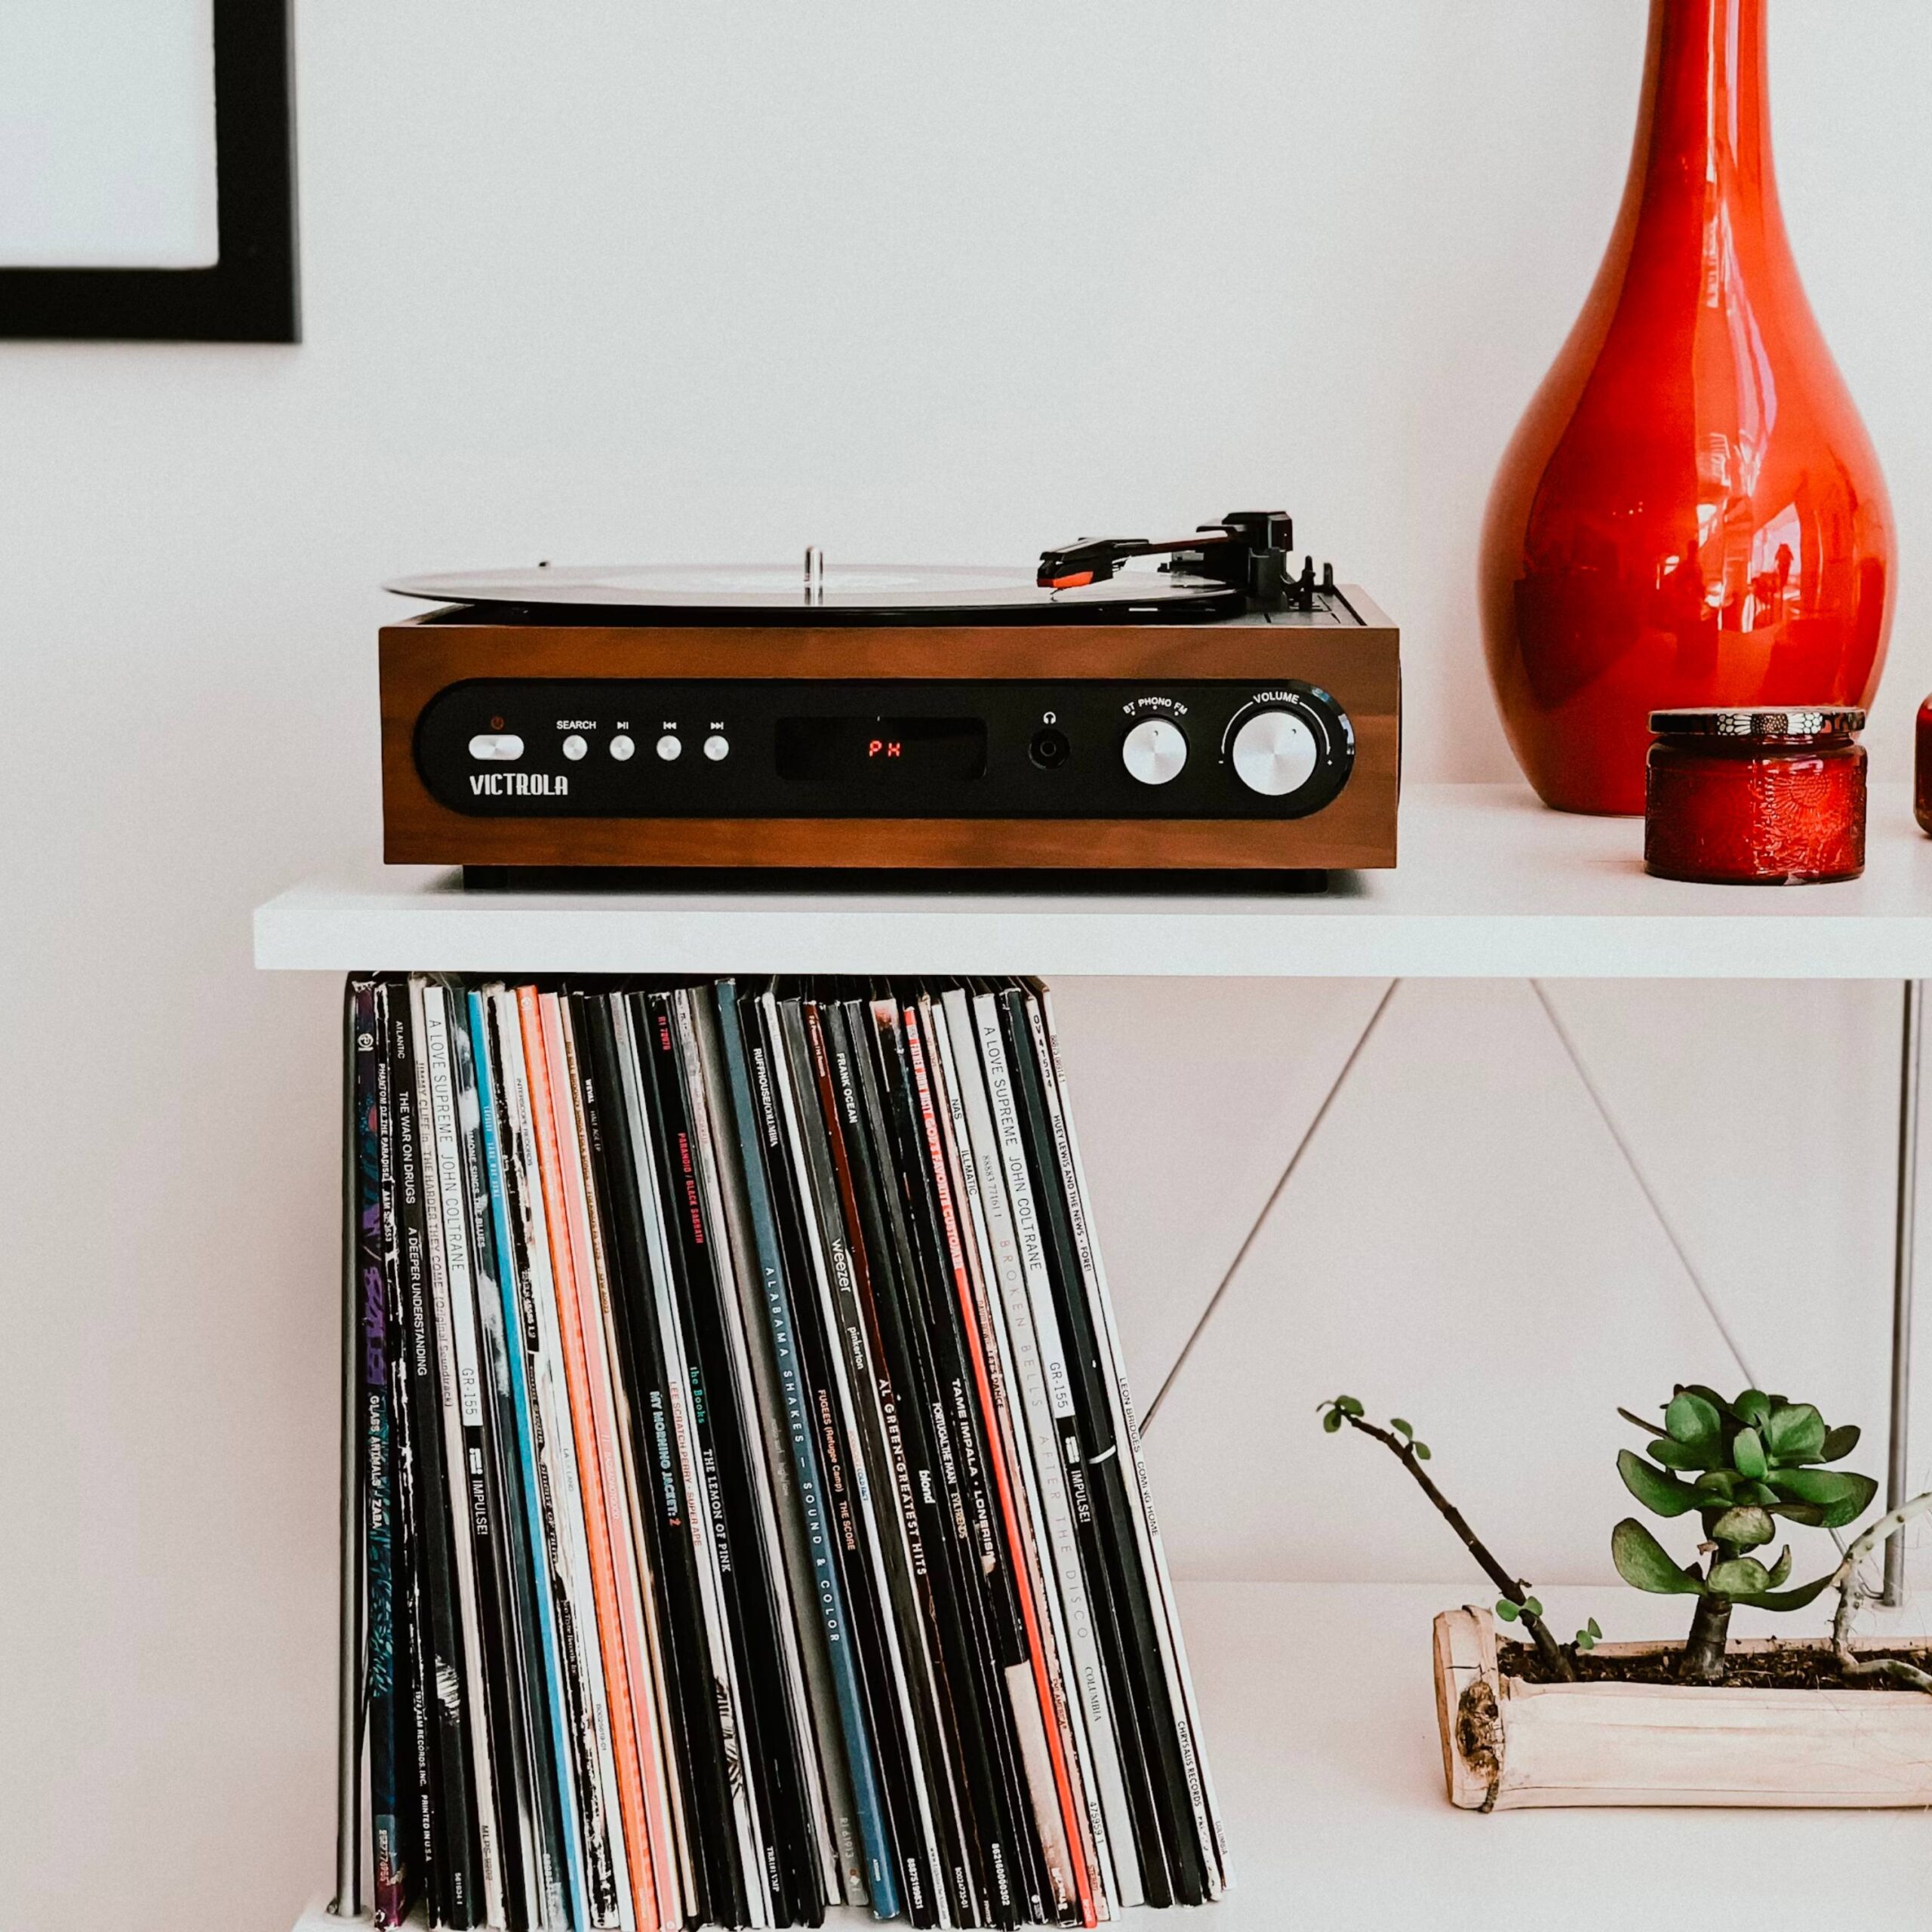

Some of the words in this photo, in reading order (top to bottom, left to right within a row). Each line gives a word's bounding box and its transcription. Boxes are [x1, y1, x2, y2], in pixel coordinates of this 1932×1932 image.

[1123, 702, 1137, 715] BT
[1138, 697, 1172, 708] PHONO
[1173, 702, 1189, 715] FM
[1253, 691, 1300, 704] VOLUME
[556, 721, 596, 730] SEARCH
[469, 774, 568, 795] VICTROLA
[395, 1021, 405, 1058] ATLANTIC
[429, 1035, 445, 1068] LOVE
[909, 1043, 924, 1069] FATHER
[986, 1041, 1004, 1072] LOVE
[377, 1063, 387, 1103] PHANTOM
[416, 1060, 426, 1096] JIMMY
[835, 1053, 851, 1087] FRANK
[914, 1072, 928, 1090] JOHN
[398, 1091, 410, 1112] THE
[583, 1079, 595, 1103] WEVAL
[752, 1048, 779, 1147] RUFFHOUSE/COLUMBIA
[842, 1089, 858, 1123] OCEAN
[918, 1092, 933, 1114] MISTY
[418, 1100, 429, 1130] CLIFF
[433, 1075, 452, 1143] SUPREME
[516, 1078, 528, 1127] INTERSCOPE
[522, 1128, 534, 1166] RECORDS
[949, 1099, 963, 1120] NAS
[993, 1079, 1019, 1146] SUPREME
[380, 1119, 389, 1135] THE
[399, 1116, 411, 1142] WAR
[923, 1118, 940, 1152] GOD'S
[1051, 1115, 1064, 1138] HUEY
[380, 1137, 390, 1177] PARADISE
[676, 1133, 692, 1173] PARANOID
[981, 1155, 995, 1182] 88883
[1057, 1141, 1070, 1167] LEWIS
[403, 1164, 415, 1204] DRUGS
[440, 1154, 457, 1191] JOHN
[469, 1165, 480, 1192] SINGS
[931, 1155, 951, 1205] FAVORITE
[960, 1149, 977, 1195] ILLMATIC
[1008, 1155, 1027, 1192] JOHN
[1063, 1170, 1075, 1188] AND
[423, 1175, 437, 1220] HARDER
[685, 1180, 697, 1205] BLACK
[987, 1184, 1000, 1210] 77161
[1067, 1190, 1078, 1206] THE
[428, 1223, 440, 1251] THEY
[445, 1198, 464, 1271] COLTRANE
[474, 1217, 486, 1247] BLUES
[689, 1208, 704, 1244] SABBATH
[1016, 1198, 1043, 1271] COLTRANE
[1071, 1208, 1084, 1235] NEWS
[941, 1208, 964, 1270] CUSTOMER
[408, 1238, 420, 1280] DEEPER
[1079, 1246, 1092, 1272] FORE!
[829, 1238, 851, 1292] weezer
[846, 1326, 866, 1369] pinkerton
[411, 1283, 427, 1376] UNDERSTANDING
[460, 1368, 477, 1414] GR-155
[669, 1381, 679, 1400] LEE
[688, 1367, 700, 1384] the
[991, 1377, 1004, 1408] DANCE
[1048, 1362, 1069, 1408] GR-155
[1118, 1377, 1131, 1404] LEON
[368, 1395, 380, 1432] GLASS
[692, 1389, 707, 1423] Books
[817, 1389, 832, 1425] FUGEES
[950, 1378, 968, 1418] TAME
[651, 1411, 672, 1469] MORNING
[672, 1402, 687, 1448] SCRATCH
[998, 1240, 1026, 1327] BROKEN
[1020, 1346, 1043, 1407] BELLS
[1038, 1436, 1061, 1499] AFTER
[1054, 1516, 1072, 1553] THE
[1064, 1571, 1089, 1638] DISCO
[1124, 1407, 1141, 1452] BRIDGES
[369, 1436, 382, 1486] ANIMALS
[702, 1449, 715, 1472] THE
[764, 1267, 789, 1356] ALABAMA
[782, 1370, 804, 1443] SHAKES
[801, 1482, 823, 1544] SOUND
[819, 1580, 840, 1641] COLOR
[822, 1427, 839, 1463] (Refugee
[958, 1422, 979, 1476] IMPALA
[679, 1451, 692, 1483] PERRY
[829, 1465, 844, 1492] Camp)
[1135, 1461, 1152, 1503] COMING
[660, 1472, 678, 1516] JACKET:
[706, 1476, 723, 1519] LEMON
[918, 1470, 935, 1503] blond
[949, 1493, 962, 1509] EVIL
[1069, 1469, 1091, 1523] IMPULSE!
[371, 1500, 383, 1528] ZABA
[471, 1480, 488, 1535] IMPULSE!
[686, 1492, 699, 1524] SUPER
[838, 1500, 850, 1518] THE
[953, 1509, 968, 1539] FRIENDS
[1145, 1506, 1160, 1537] HOME
[691, 1527, 703, 1546] APE
[841, 1521, 856, 1550] SCORE
[717, 1543, 732, 1572] PINK
[911, 1543, 927, 1575] HITS
[1083, 1666, 1103, 1721] COLUMBIA
[1176, 1721, 1193, 1764] CHRYSALIS
[1186, 1767, 1203, 1807] RECORDS
[420, 1795, 430, 1829] PRINTED
[1088, 1801, 1103, 1835] 475959
